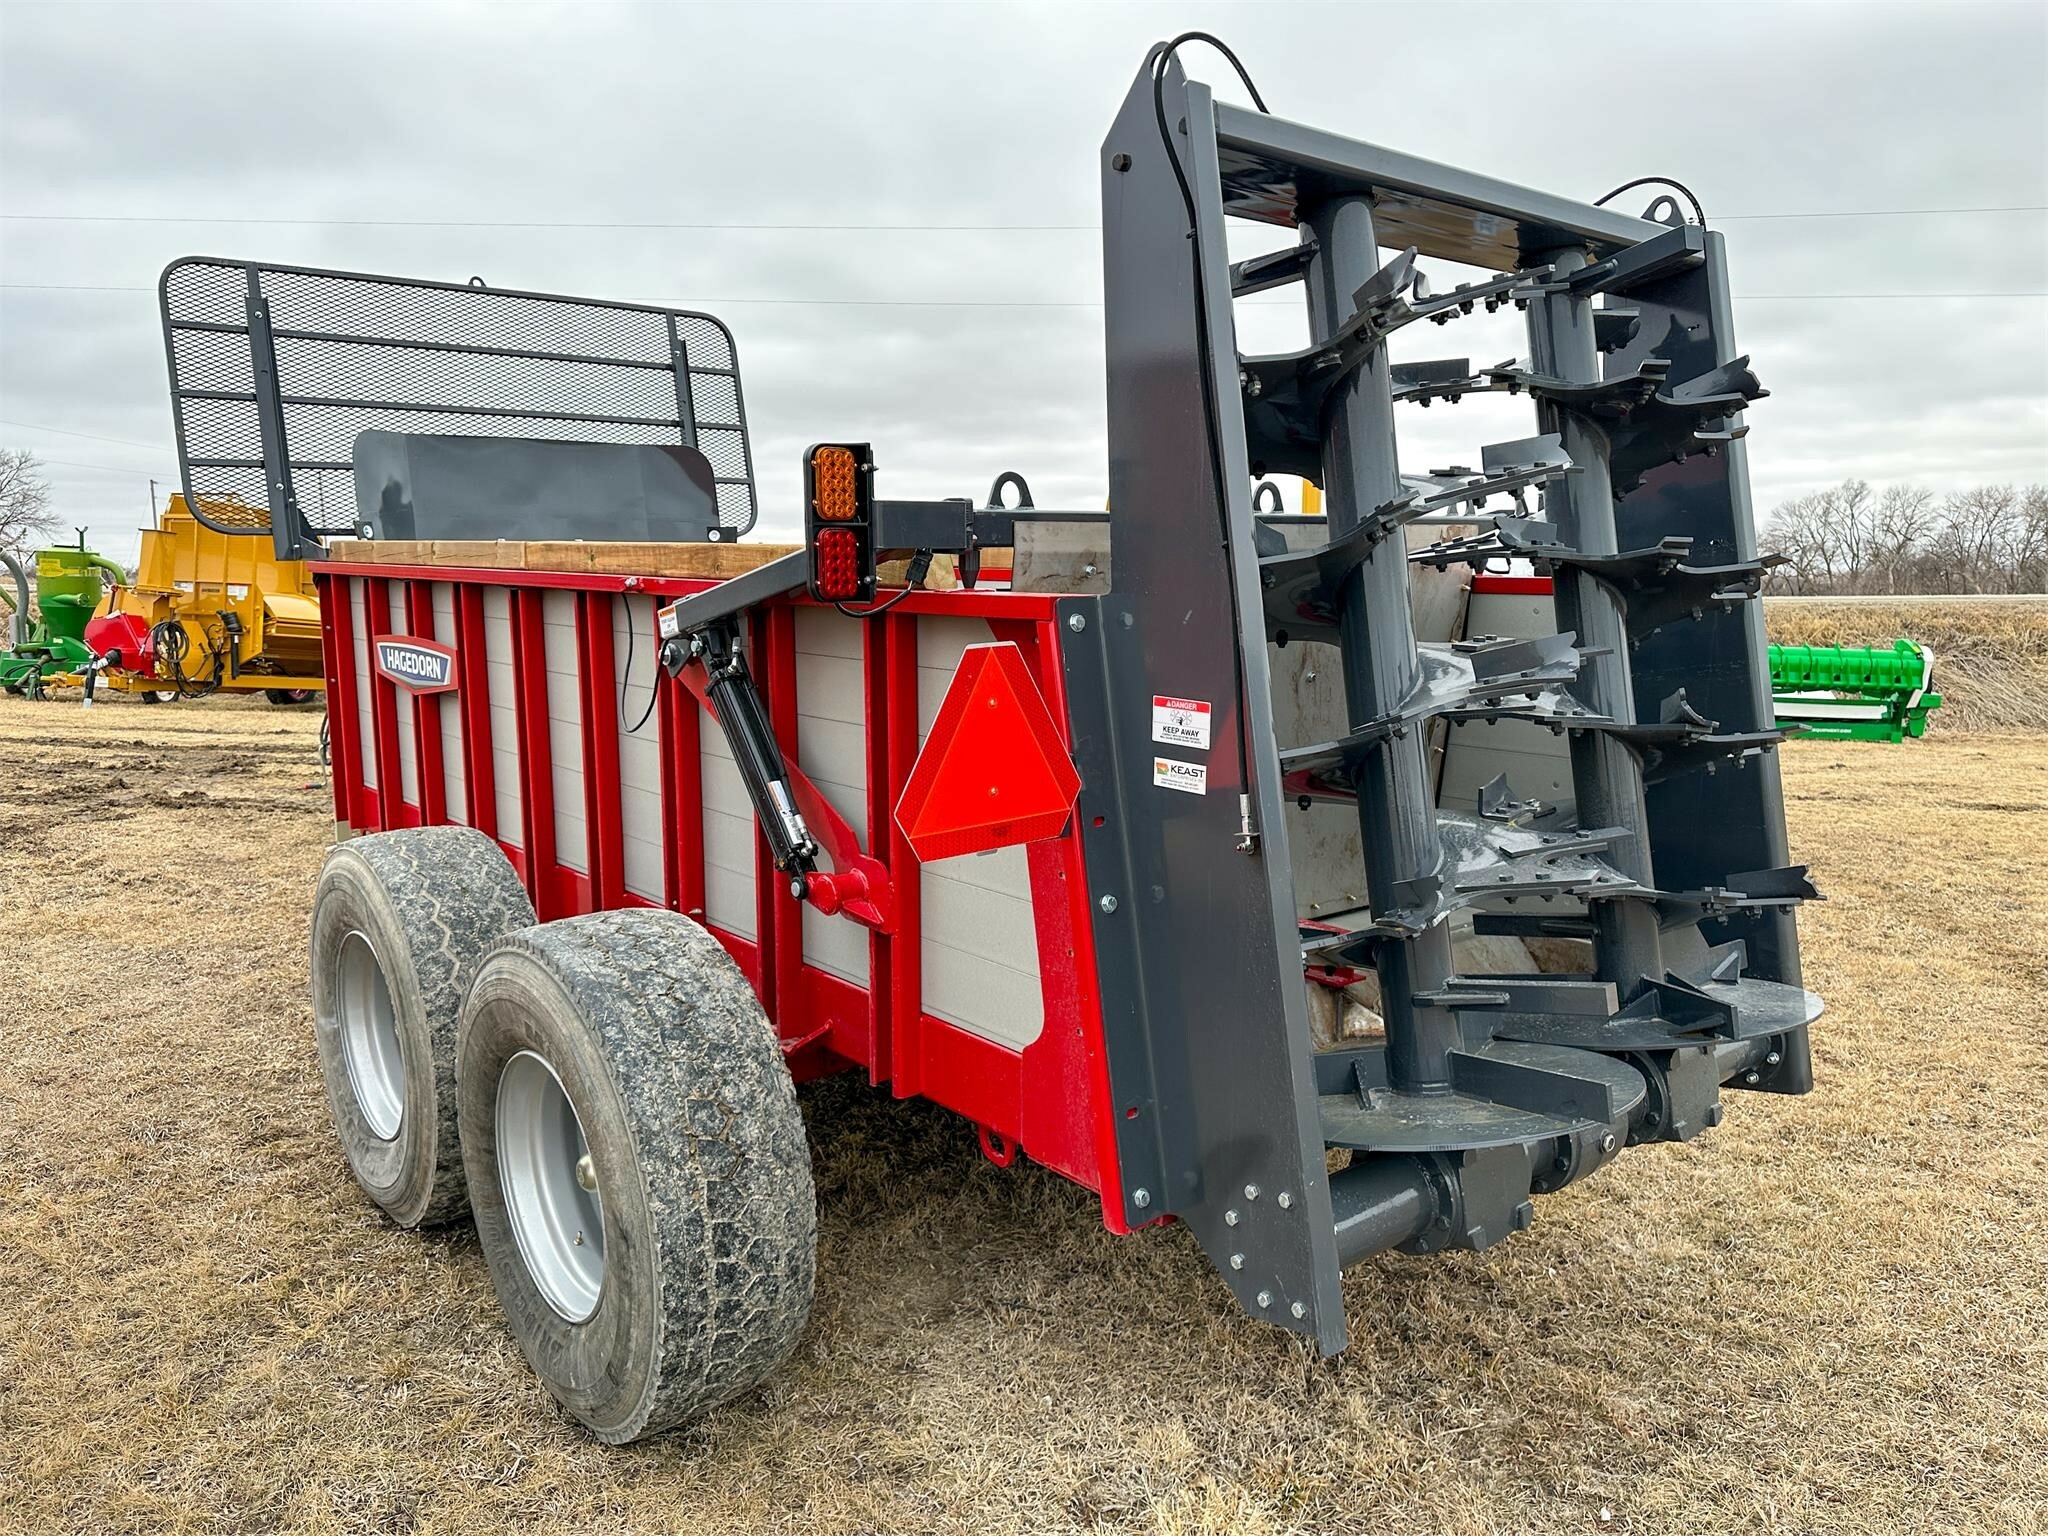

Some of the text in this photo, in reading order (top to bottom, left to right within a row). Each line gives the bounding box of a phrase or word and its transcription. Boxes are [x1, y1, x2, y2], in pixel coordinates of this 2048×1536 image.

[386, 648, 441, 679] HAGEDORN
[1172, 700, 1197, 711] DANGER
[1162, 725, 1180, 734] KEEP
[1180, 728, 1200, 738] AWAY
[1171, 765, 1204, 778] KEAST
